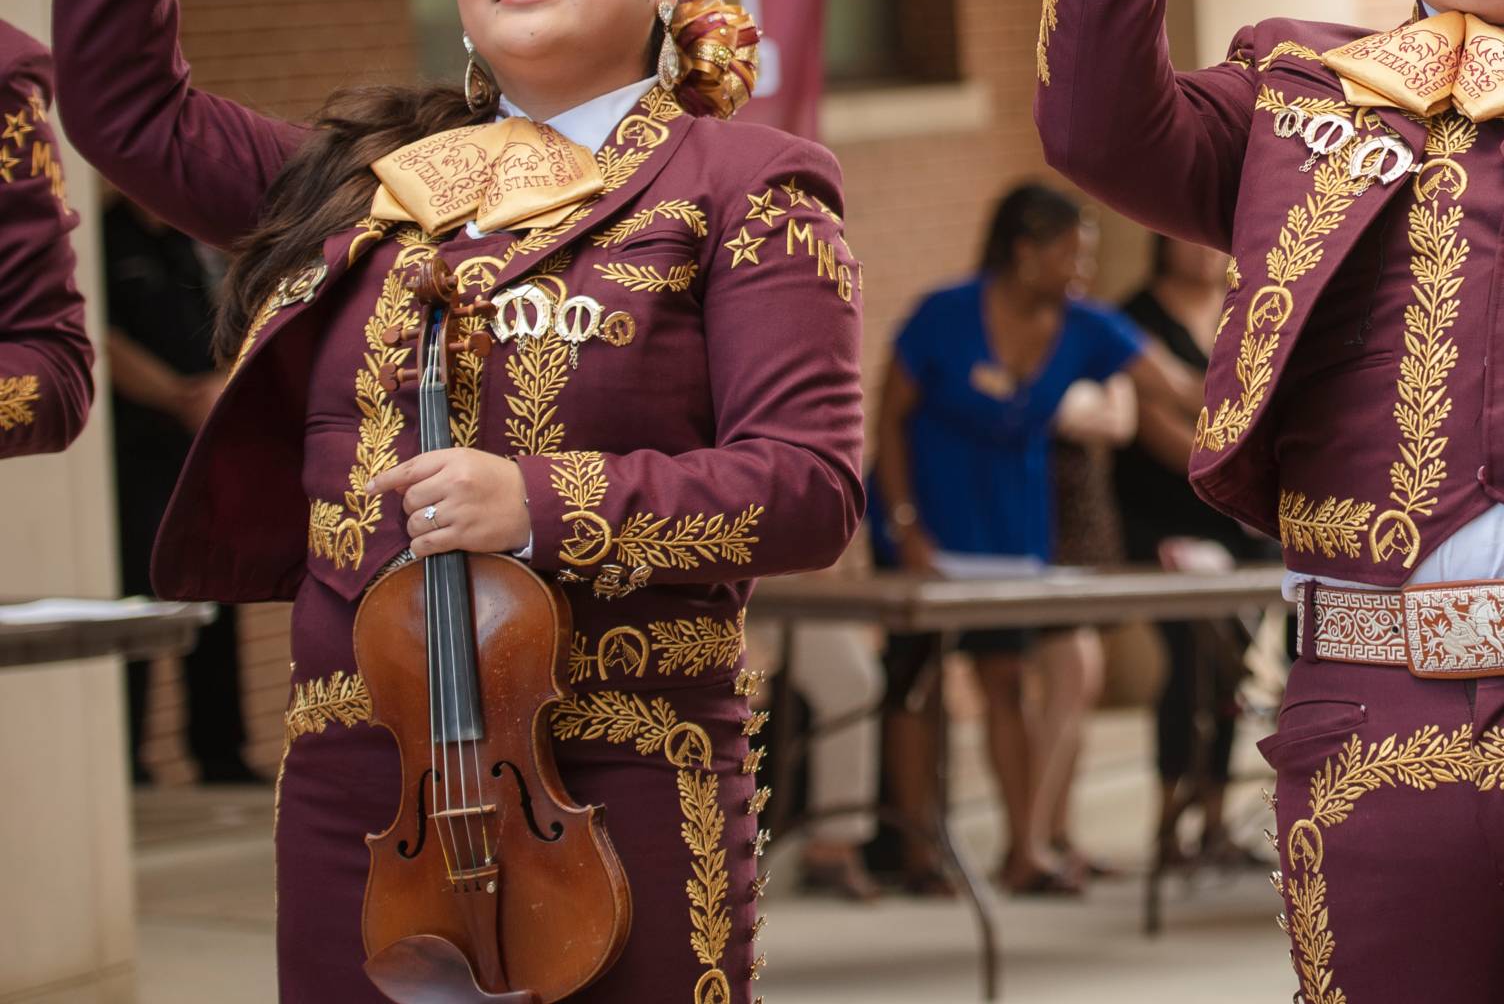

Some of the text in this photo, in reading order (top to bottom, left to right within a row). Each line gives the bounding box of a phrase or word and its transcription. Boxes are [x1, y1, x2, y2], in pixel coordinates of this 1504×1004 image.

[1372, 49, 1418, 77] TEXAS
[414, 160, 553, 193] TEXAS STATE
